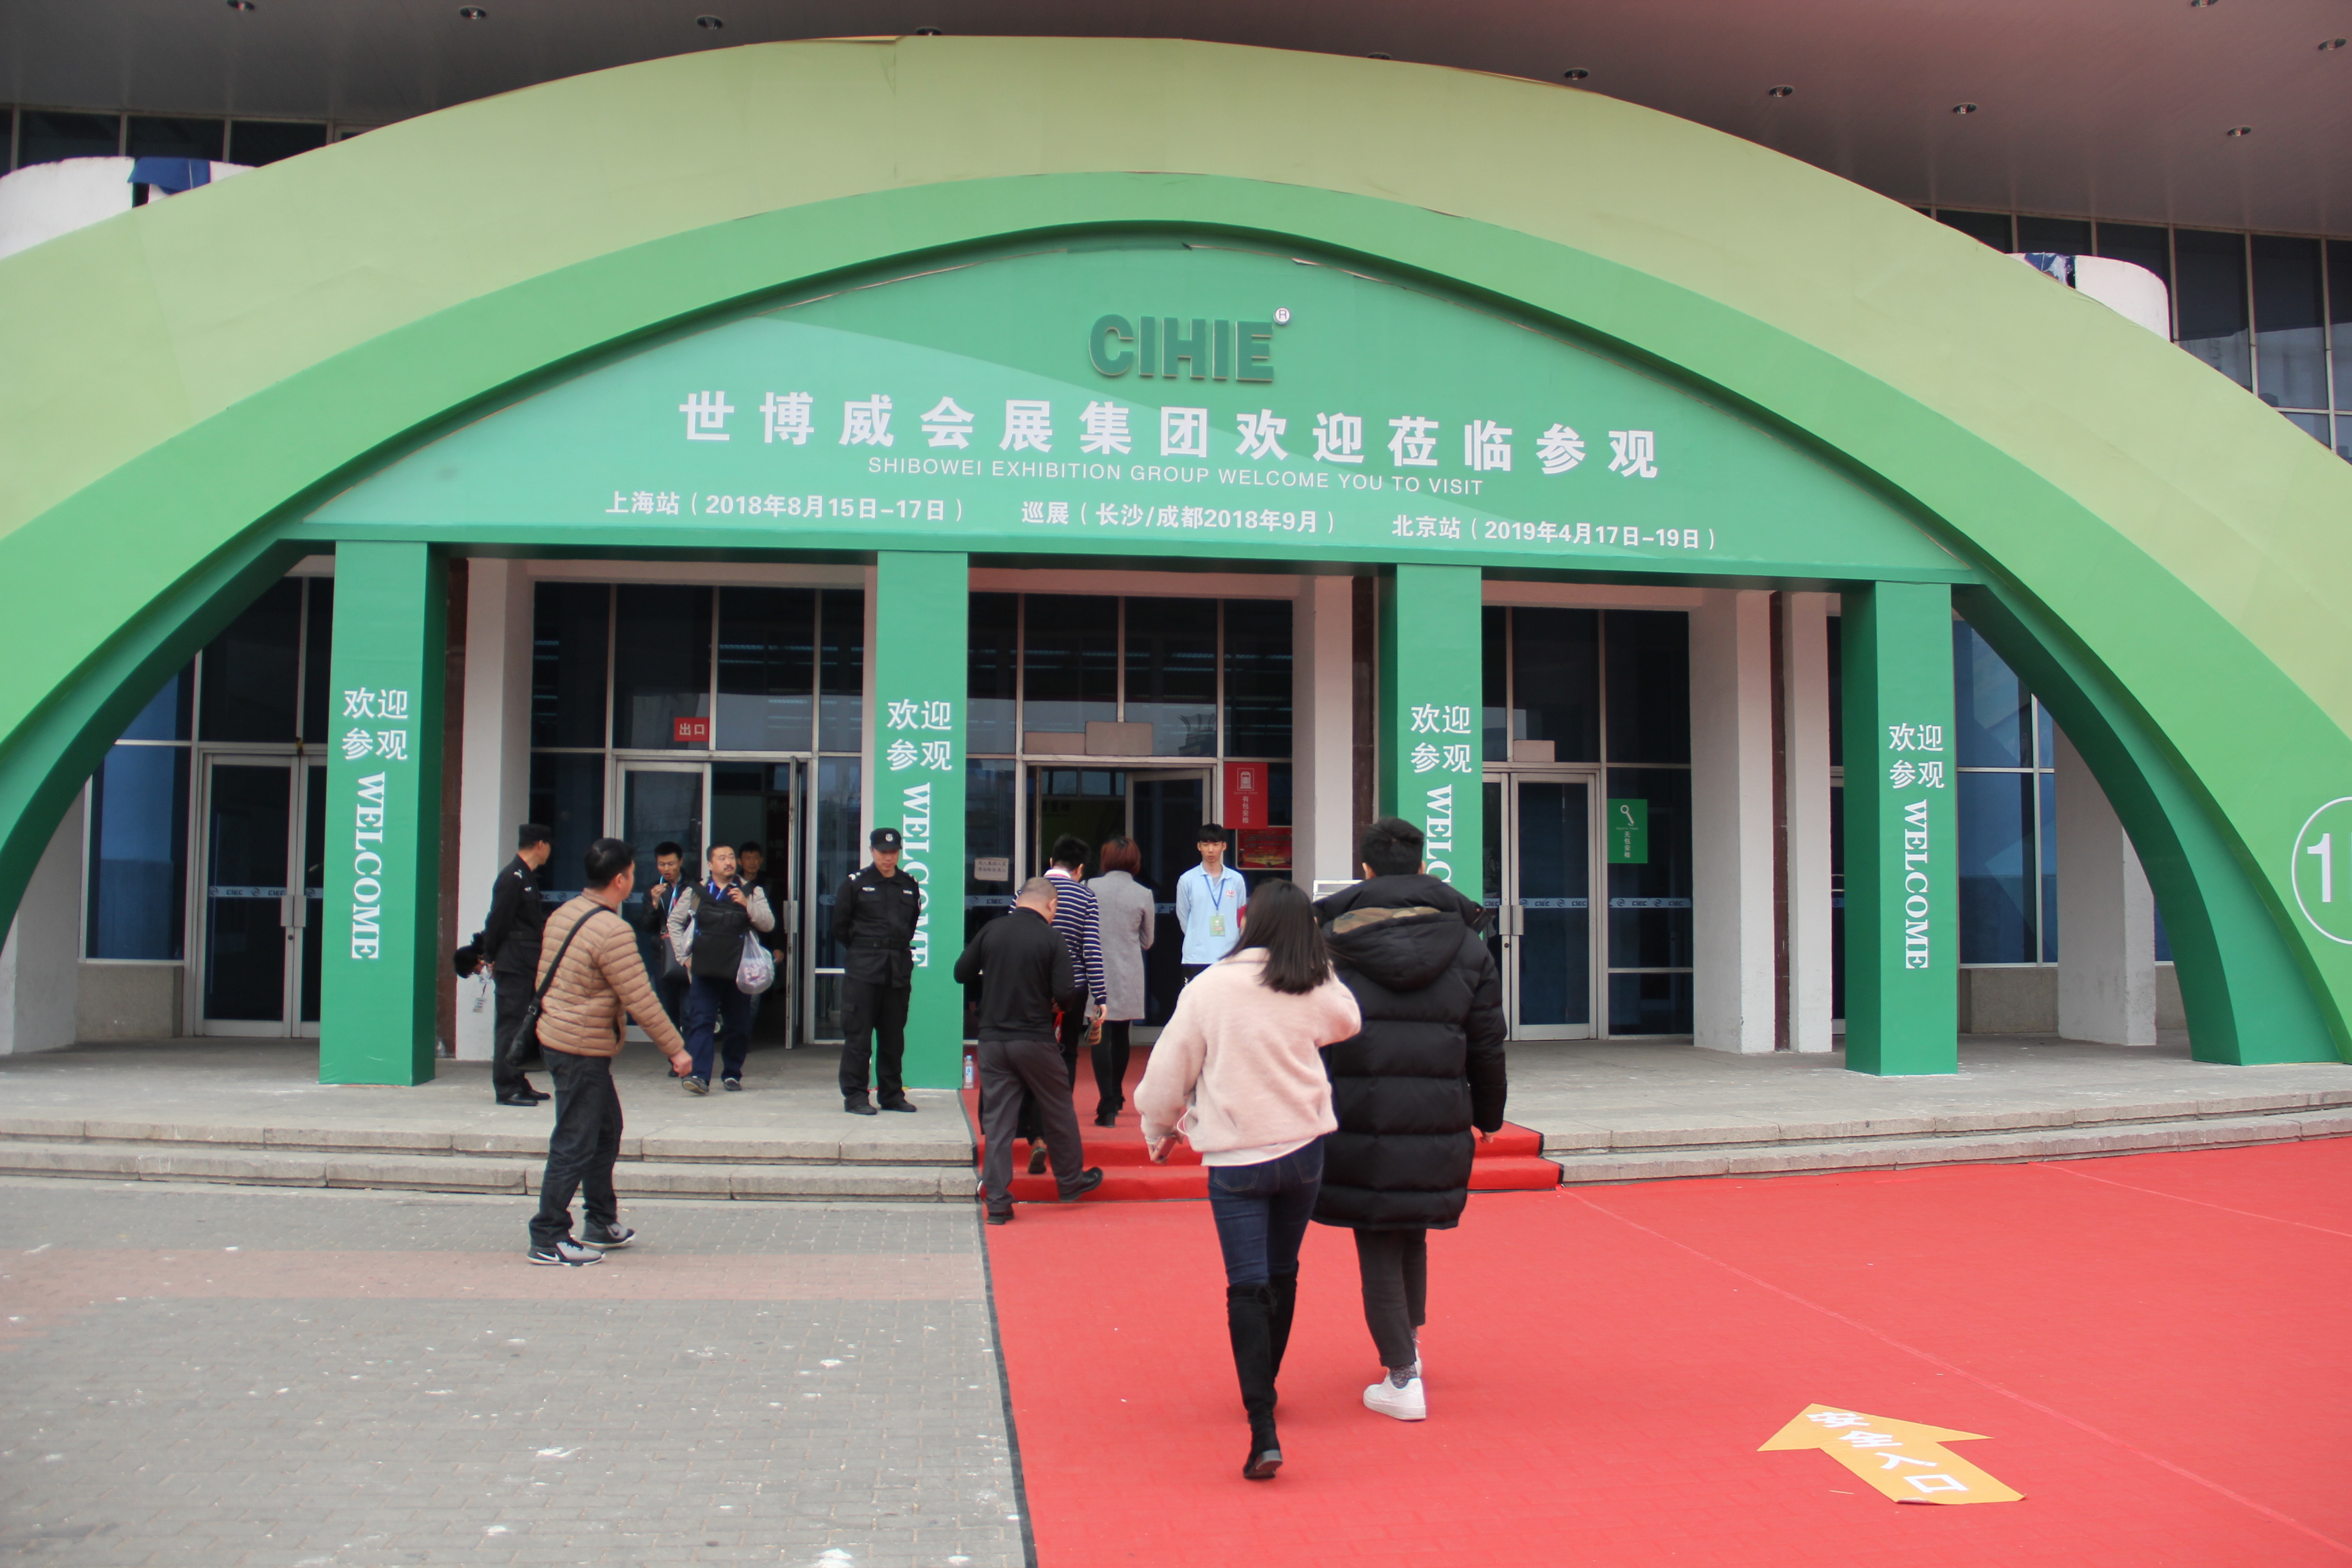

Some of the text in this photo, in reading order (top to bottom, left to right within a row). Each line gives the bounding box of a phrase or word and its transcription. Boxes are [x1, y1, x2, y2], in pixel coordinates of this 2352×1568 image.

[1089, 314, 1274, 382] CIHIE
[679, 391, 1658, 479] 世博威会展集团欢迎莅临参观
[868, 457, 1483, 495] SHIBOWEI EXHIBITION GROUP WELCOME YOU TO VISIT
[342, 687, 408, 719] 欢迎
[887, 699, 951, 731] 欢迎
[1411, 703, 1471, 734] 欢迎
[342, 728, 408, 760] 参观
[679, 722, 706, 736] 出口
[1889, 723, 1944, 752] 欢迎
[887, 738, 952, 770] 参观
[1411, 742, 1472, 773] 参观
[1889, 760, 1944, 789] 参观
[351, 772, 385, 959] WELCOME
[2306, 832, 2352, 903] 1
[1904, 799, 1929, 969] WELCOME
[1805, 1411, 1970, 1494] 安全入口
